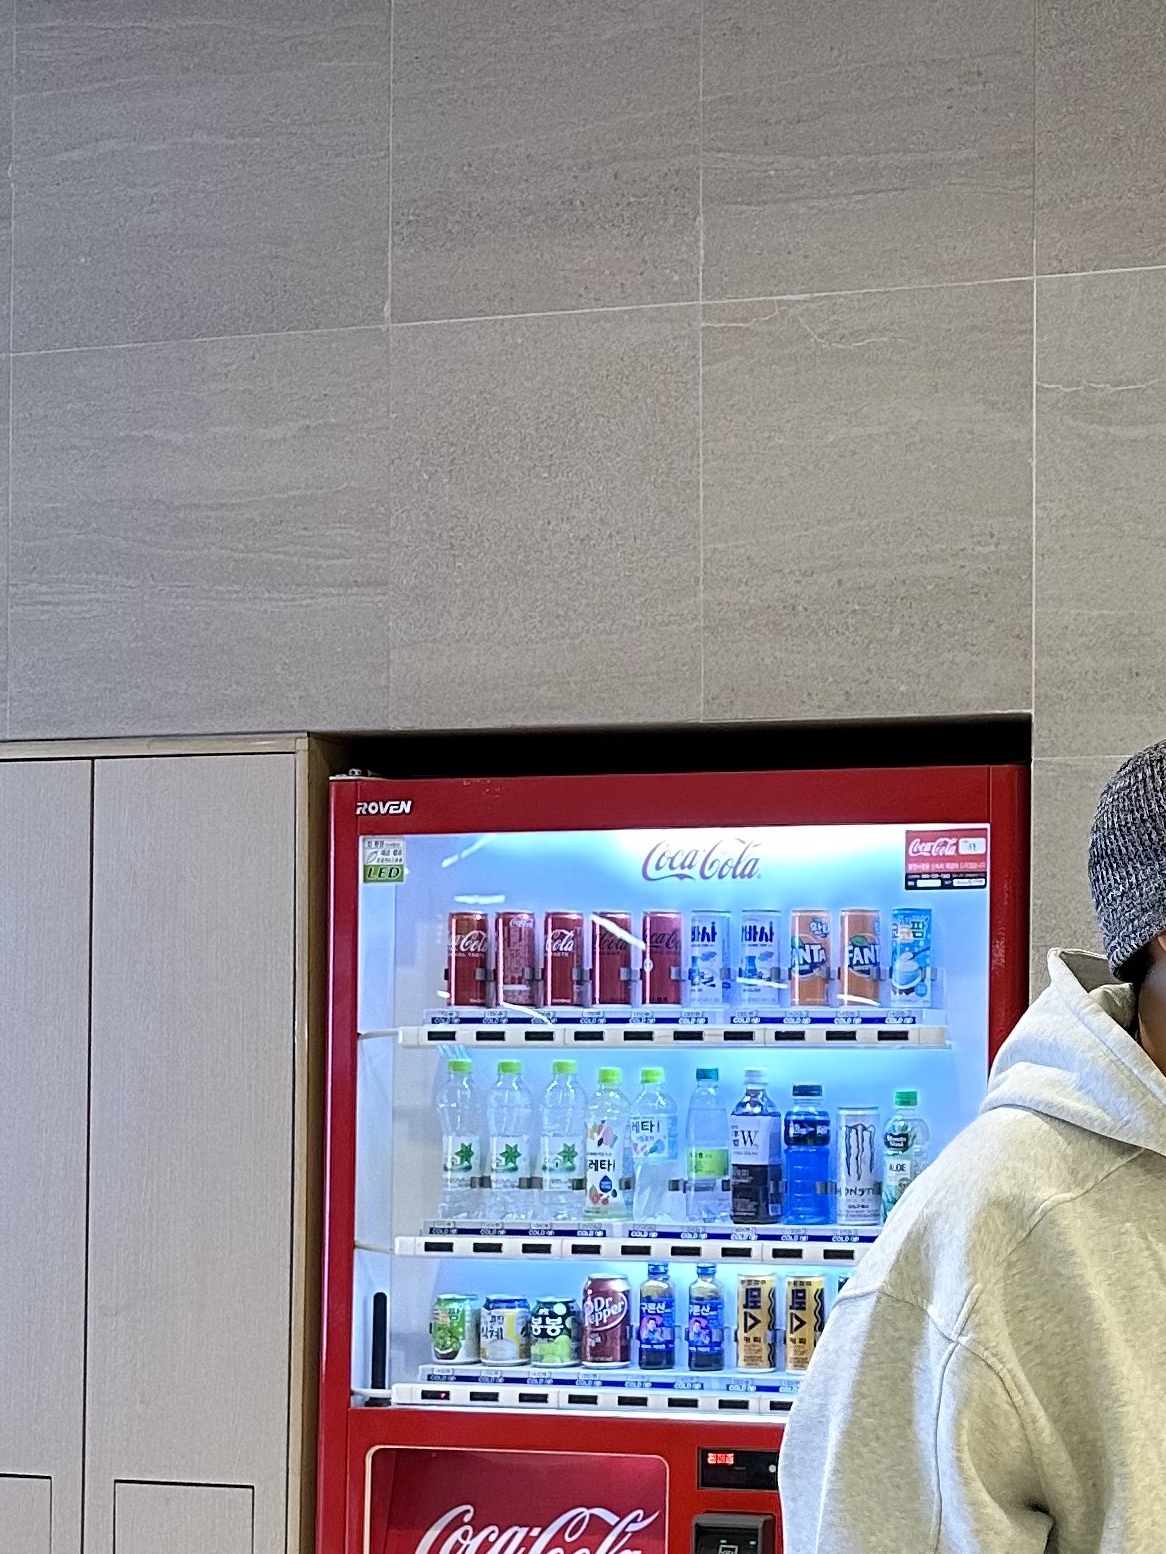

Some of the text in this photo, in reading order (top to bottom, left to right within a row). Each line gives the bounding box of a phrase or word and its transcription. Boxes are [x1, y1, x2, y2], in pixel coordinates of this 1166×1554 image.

[356, 801, 411, 814] ROVEN
[367, 867, 400, 879] LED
[593, 1297, 613, 1313] Dr
[584, 1300, 626, 1327] Pepper
[531, 1316, 564, 1336] 봉봉
